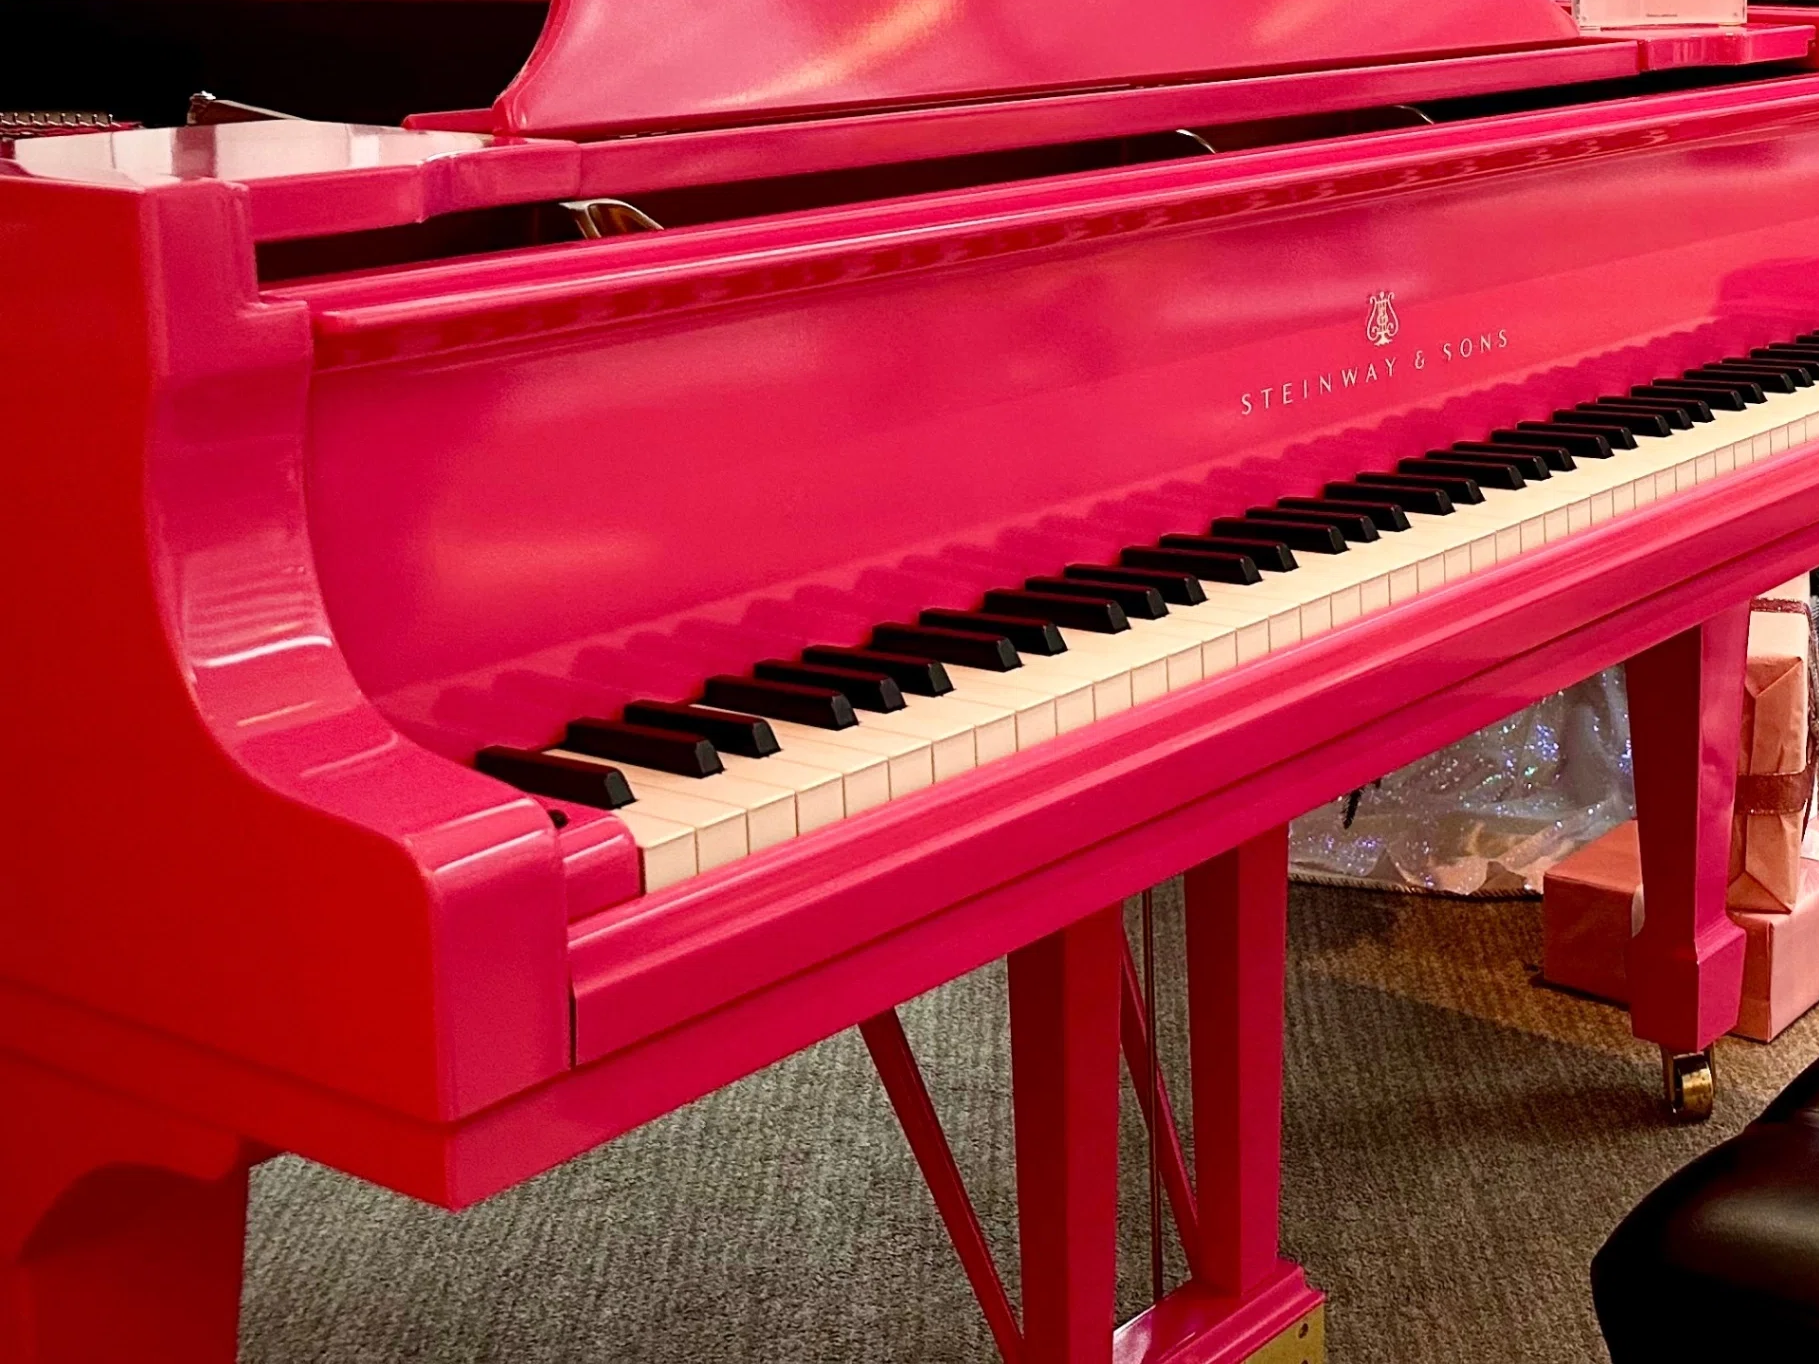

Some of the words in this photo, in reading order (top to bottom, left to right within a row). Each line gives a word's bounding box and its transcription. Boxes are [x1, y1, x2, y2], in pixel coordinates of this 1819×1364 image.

[1240, 356, 1397, 415] STEINWAY
[1414, 349, 1426, 370] &
[1442, 329, 1509, 362] SONS
